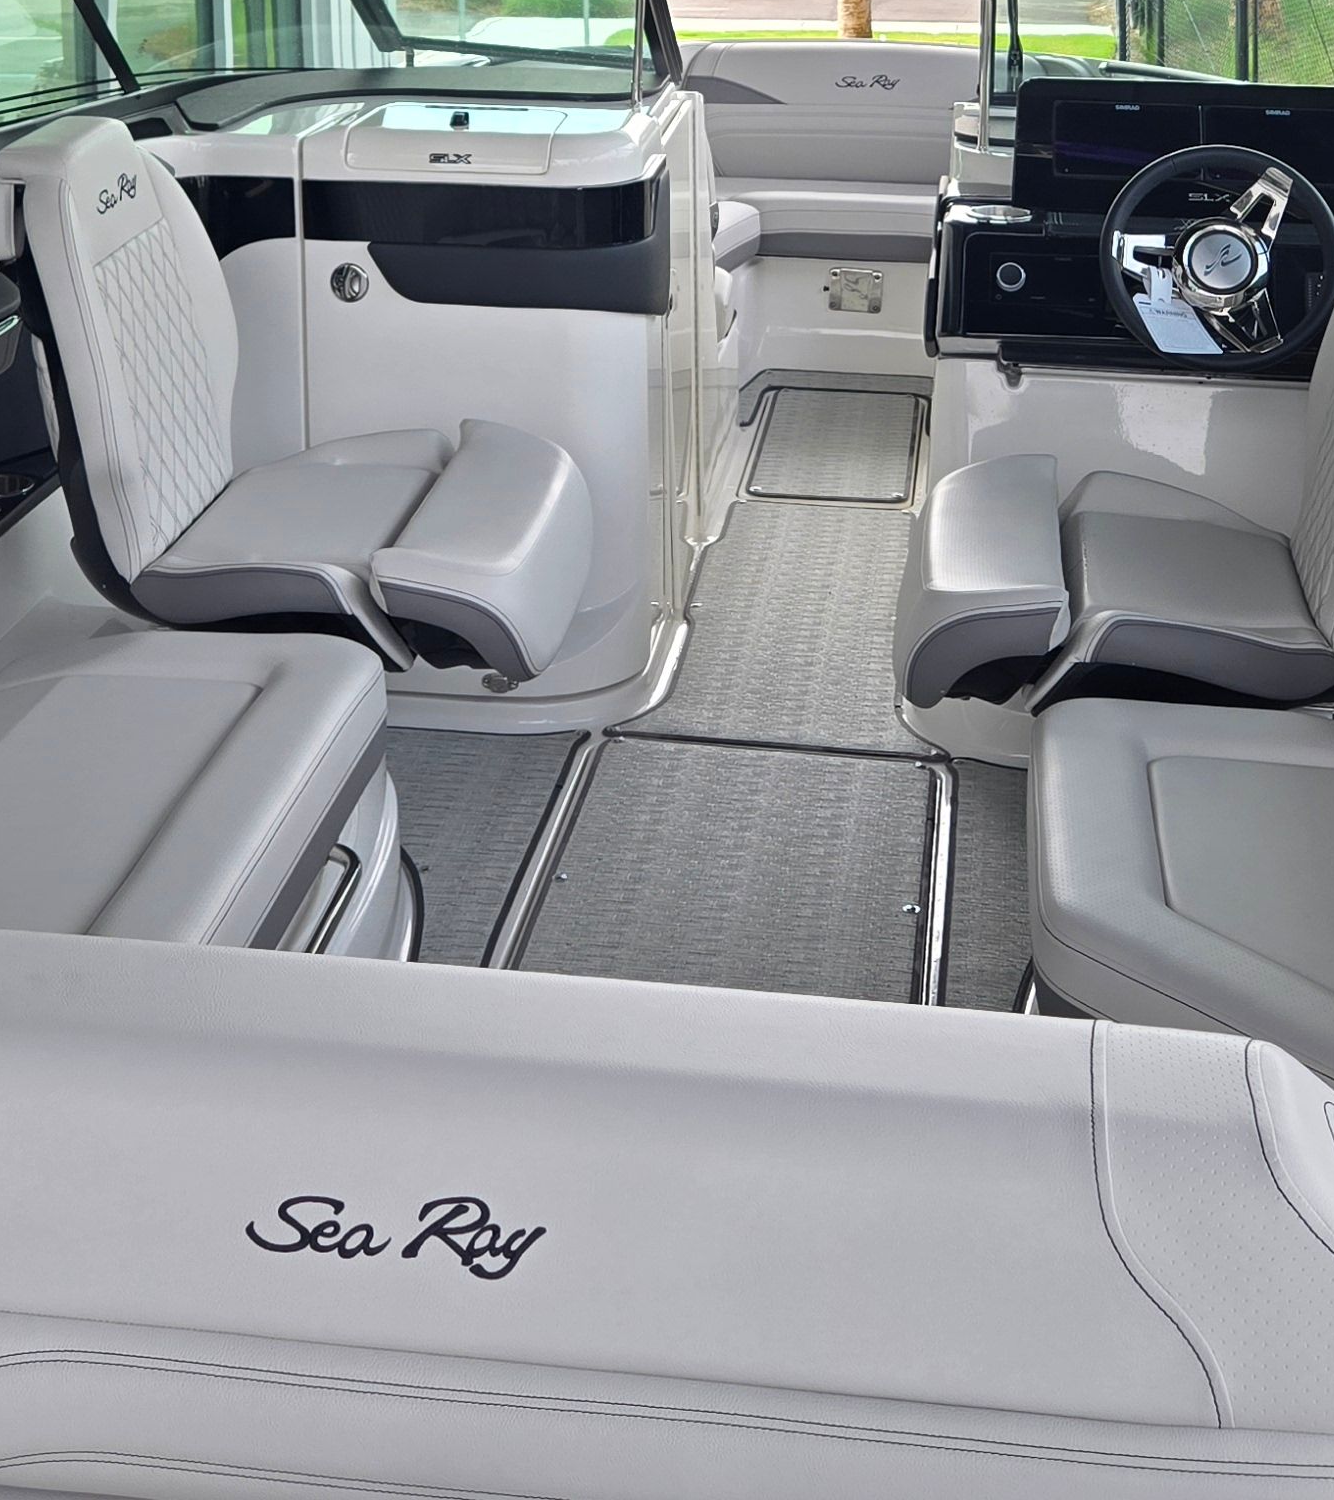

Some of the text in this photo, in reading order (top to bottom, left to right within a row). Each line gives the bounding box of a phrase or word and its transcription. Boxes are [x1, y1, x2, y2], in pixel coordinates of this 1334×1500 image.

[835, 74, 901, 90] Sea Ray
[429, 153, 472, 164] SLX
[96, 173, 137, 215] Sea Ray
[1188, 192, 1230, 202] SLX
[246, 1195, 547, 1280] Sea Ray
